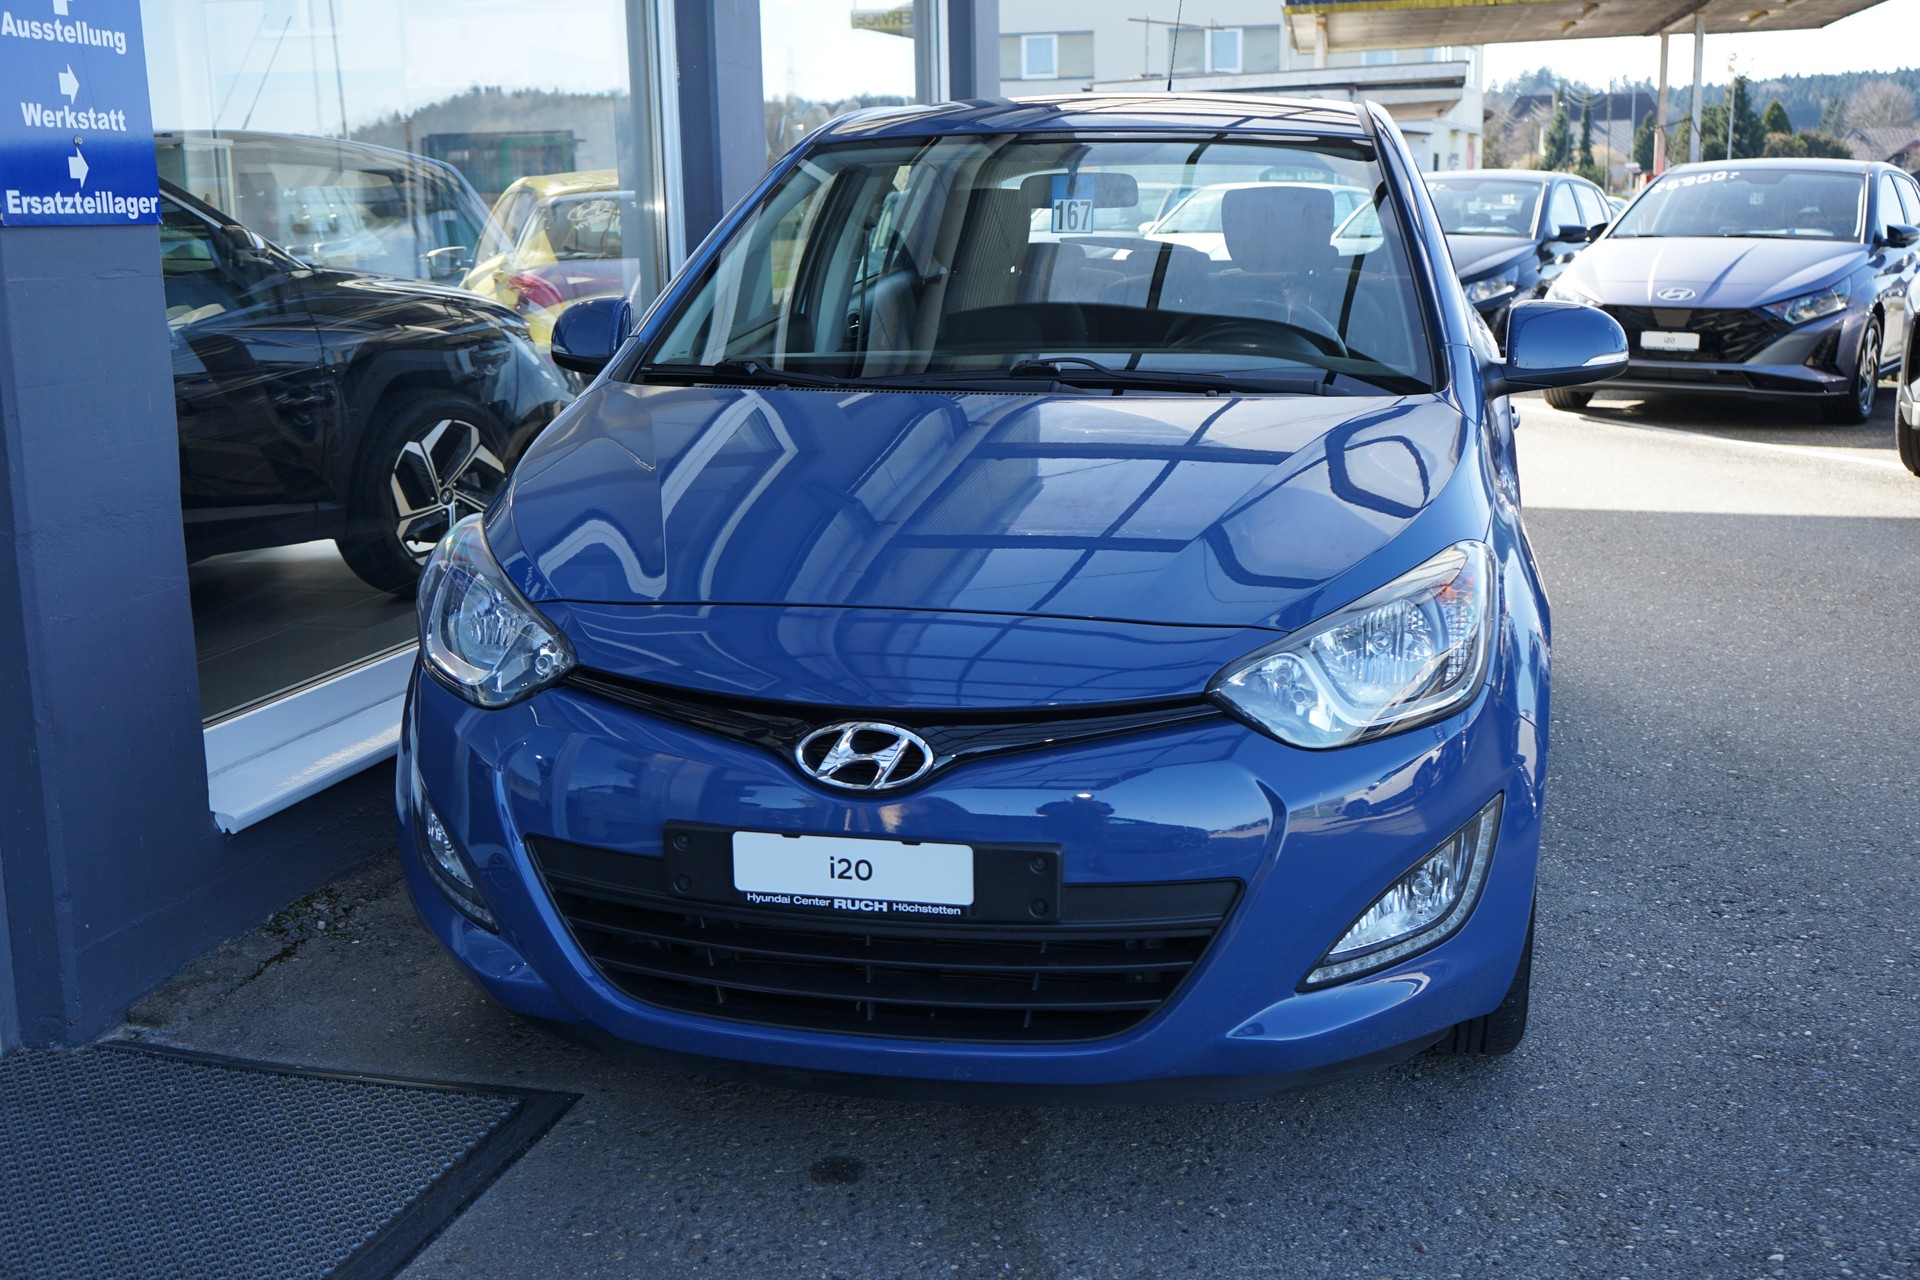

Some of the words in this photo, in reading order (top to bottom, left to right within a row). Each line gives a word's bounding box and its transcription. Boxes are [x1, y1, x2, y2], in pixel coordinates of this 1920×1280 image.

[1, 12, 127, 55] Ausstellung
[20, 102, 127, 131] Werkstatt
[6, 189, 158, 220] Ersatzteillager
[1055, 200, 1092, 231] 167
[829, 856, 873, 881] i20
[747, 893, 790, 904] Hyundai
[793, 895, 831, 907] Center
[833, 898, 888, 912] RUCH
[893, 902, 961, 916] Höchstetten
